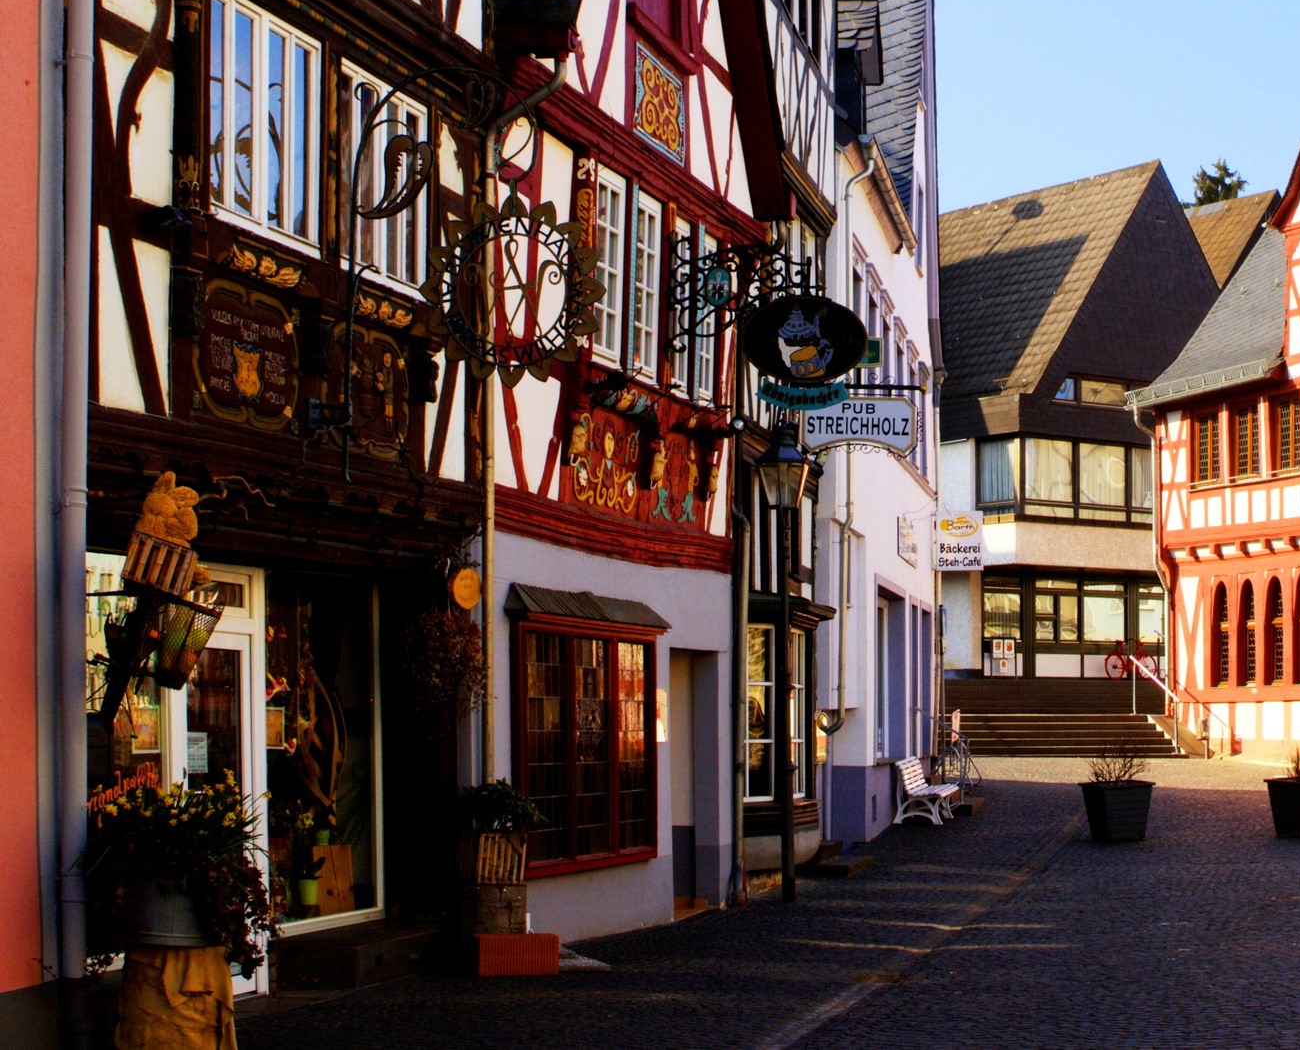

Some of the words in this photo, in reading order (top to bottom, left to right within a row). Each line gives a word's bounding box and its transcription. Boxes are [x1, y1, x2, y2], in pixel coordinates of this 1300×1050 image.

[842, 402, 876, 415] PUB
[807, 416, 910, 436] STREICHHOLZ
[939, 542, 981, 554] Bäckerei
[938, 557, 982, 567] Steh-Café
